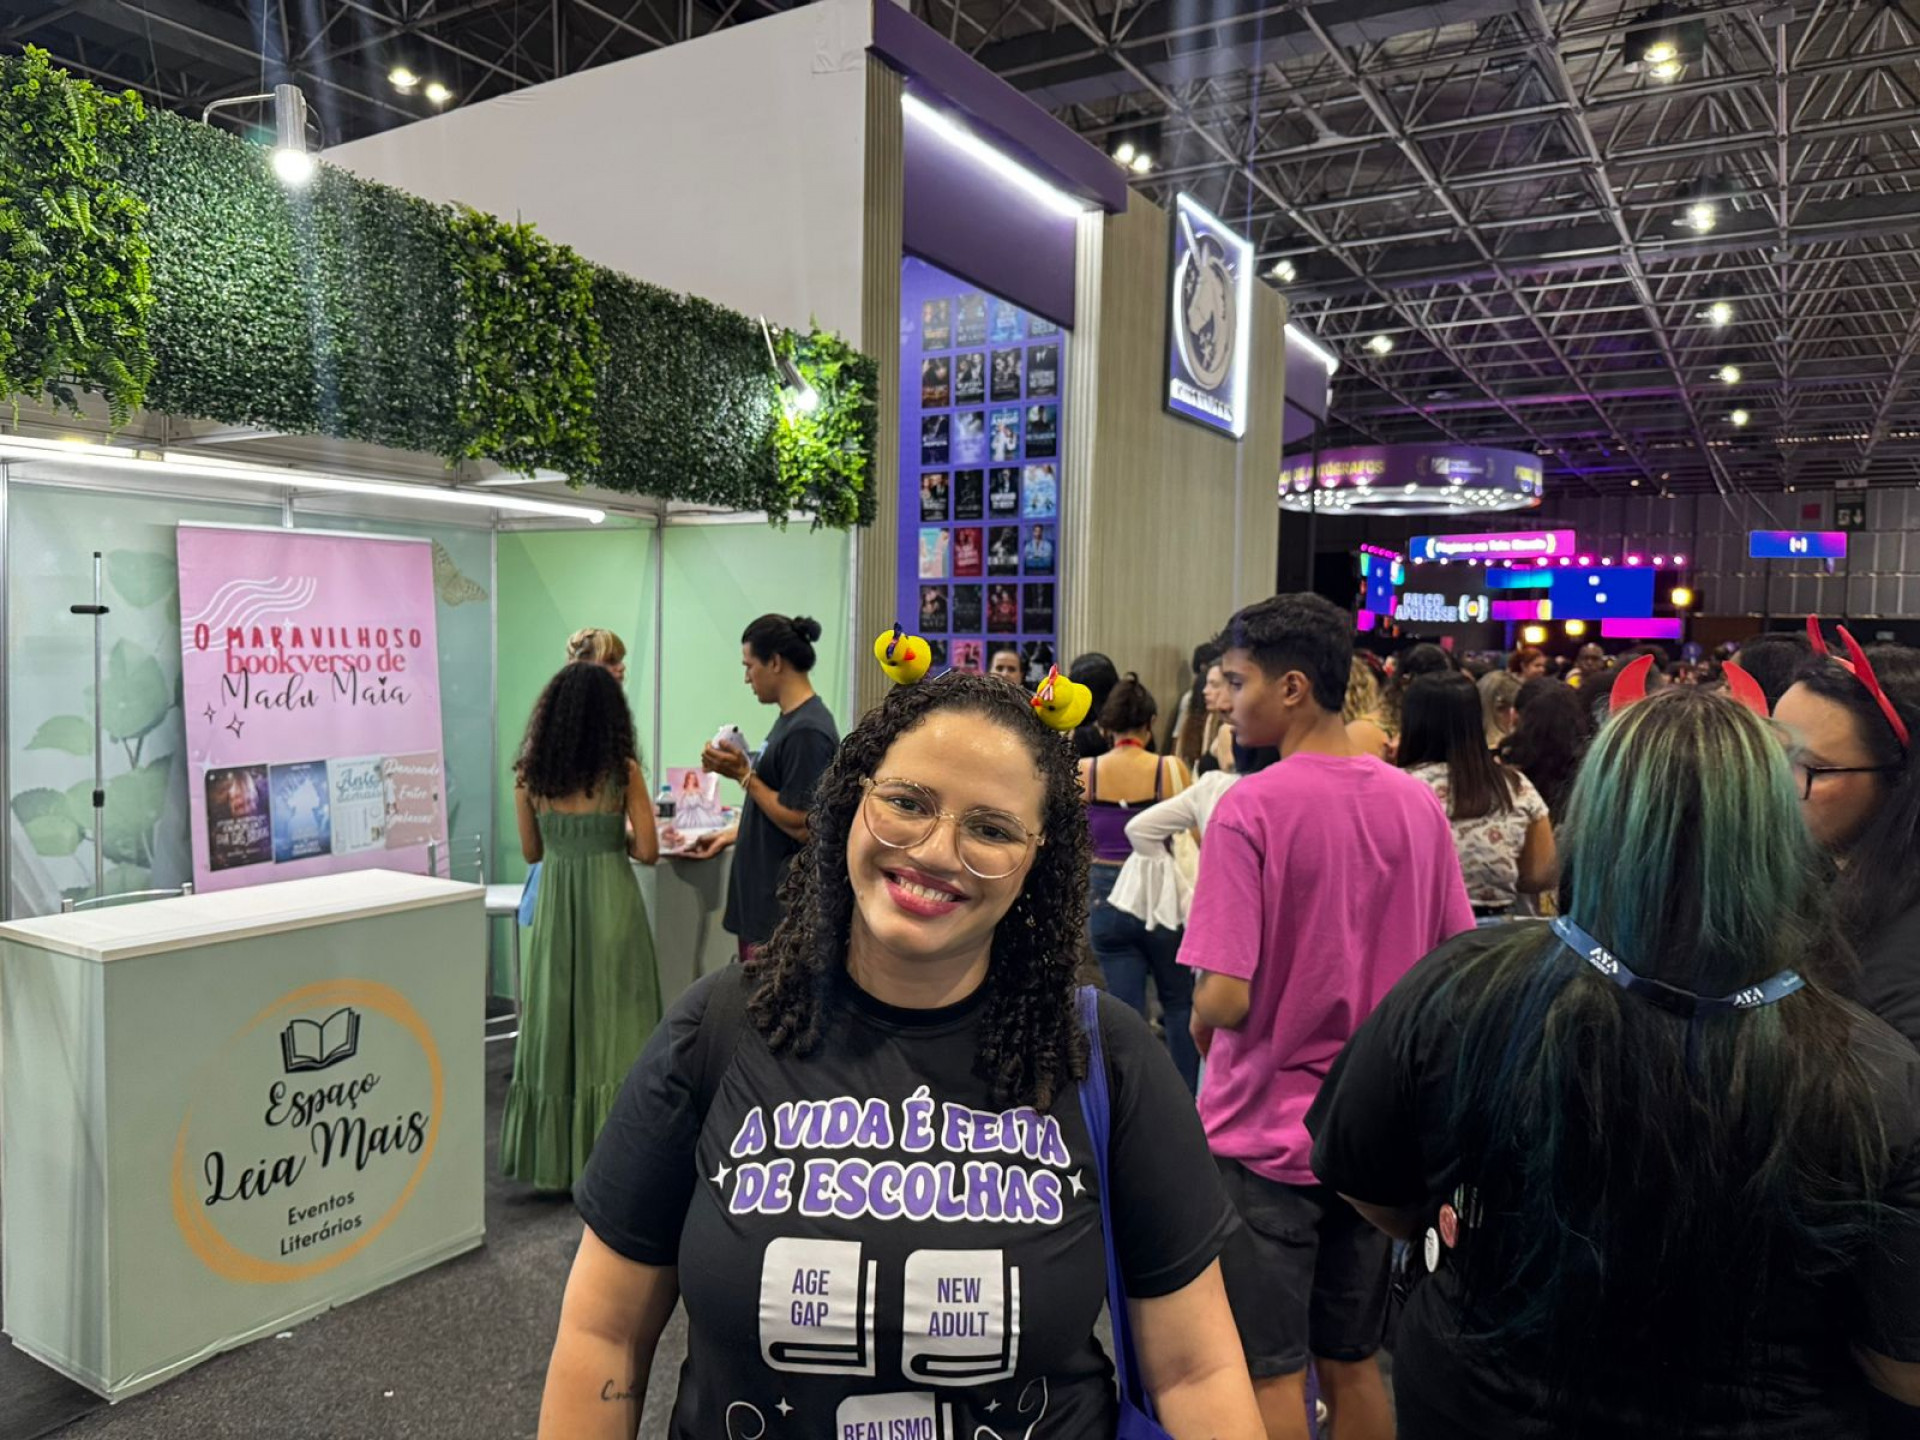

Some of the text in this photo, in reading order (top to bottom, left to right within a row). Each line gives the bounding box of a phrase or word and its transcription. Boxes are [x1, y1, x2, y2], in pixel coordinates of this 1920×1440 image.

[1307, 461, 1385, 478] ATÓGRAFOS
[1395, 605, 1457, 621] APOTEOSE
[194, 623, 421, 650] O MARAVILHOSO
[226, 643, 406, 674] bookverso de
[221, 666, 411, 710] Madu Maia
[265, 1073, 381, 1127] Espaço
[730, 1085, 1070, 1166] A VIDA É FEITA
[204, 1111, 429, 1206] Leia Mais
[729, 1158, 1063, 1224] DE ESCOLHAS
[288, 1191, 355, 1226] Eventos
[280, 1214, 363, 1256] Literários
[791, 1268, 829, 1296] AGE
[937, 1277, 981, 1304] NEW
[791, 1300, 829, 1327] GAP
[928, 1310, 989, 1338] ADULT
[843, 1416, 933, 1440] REALISMO
